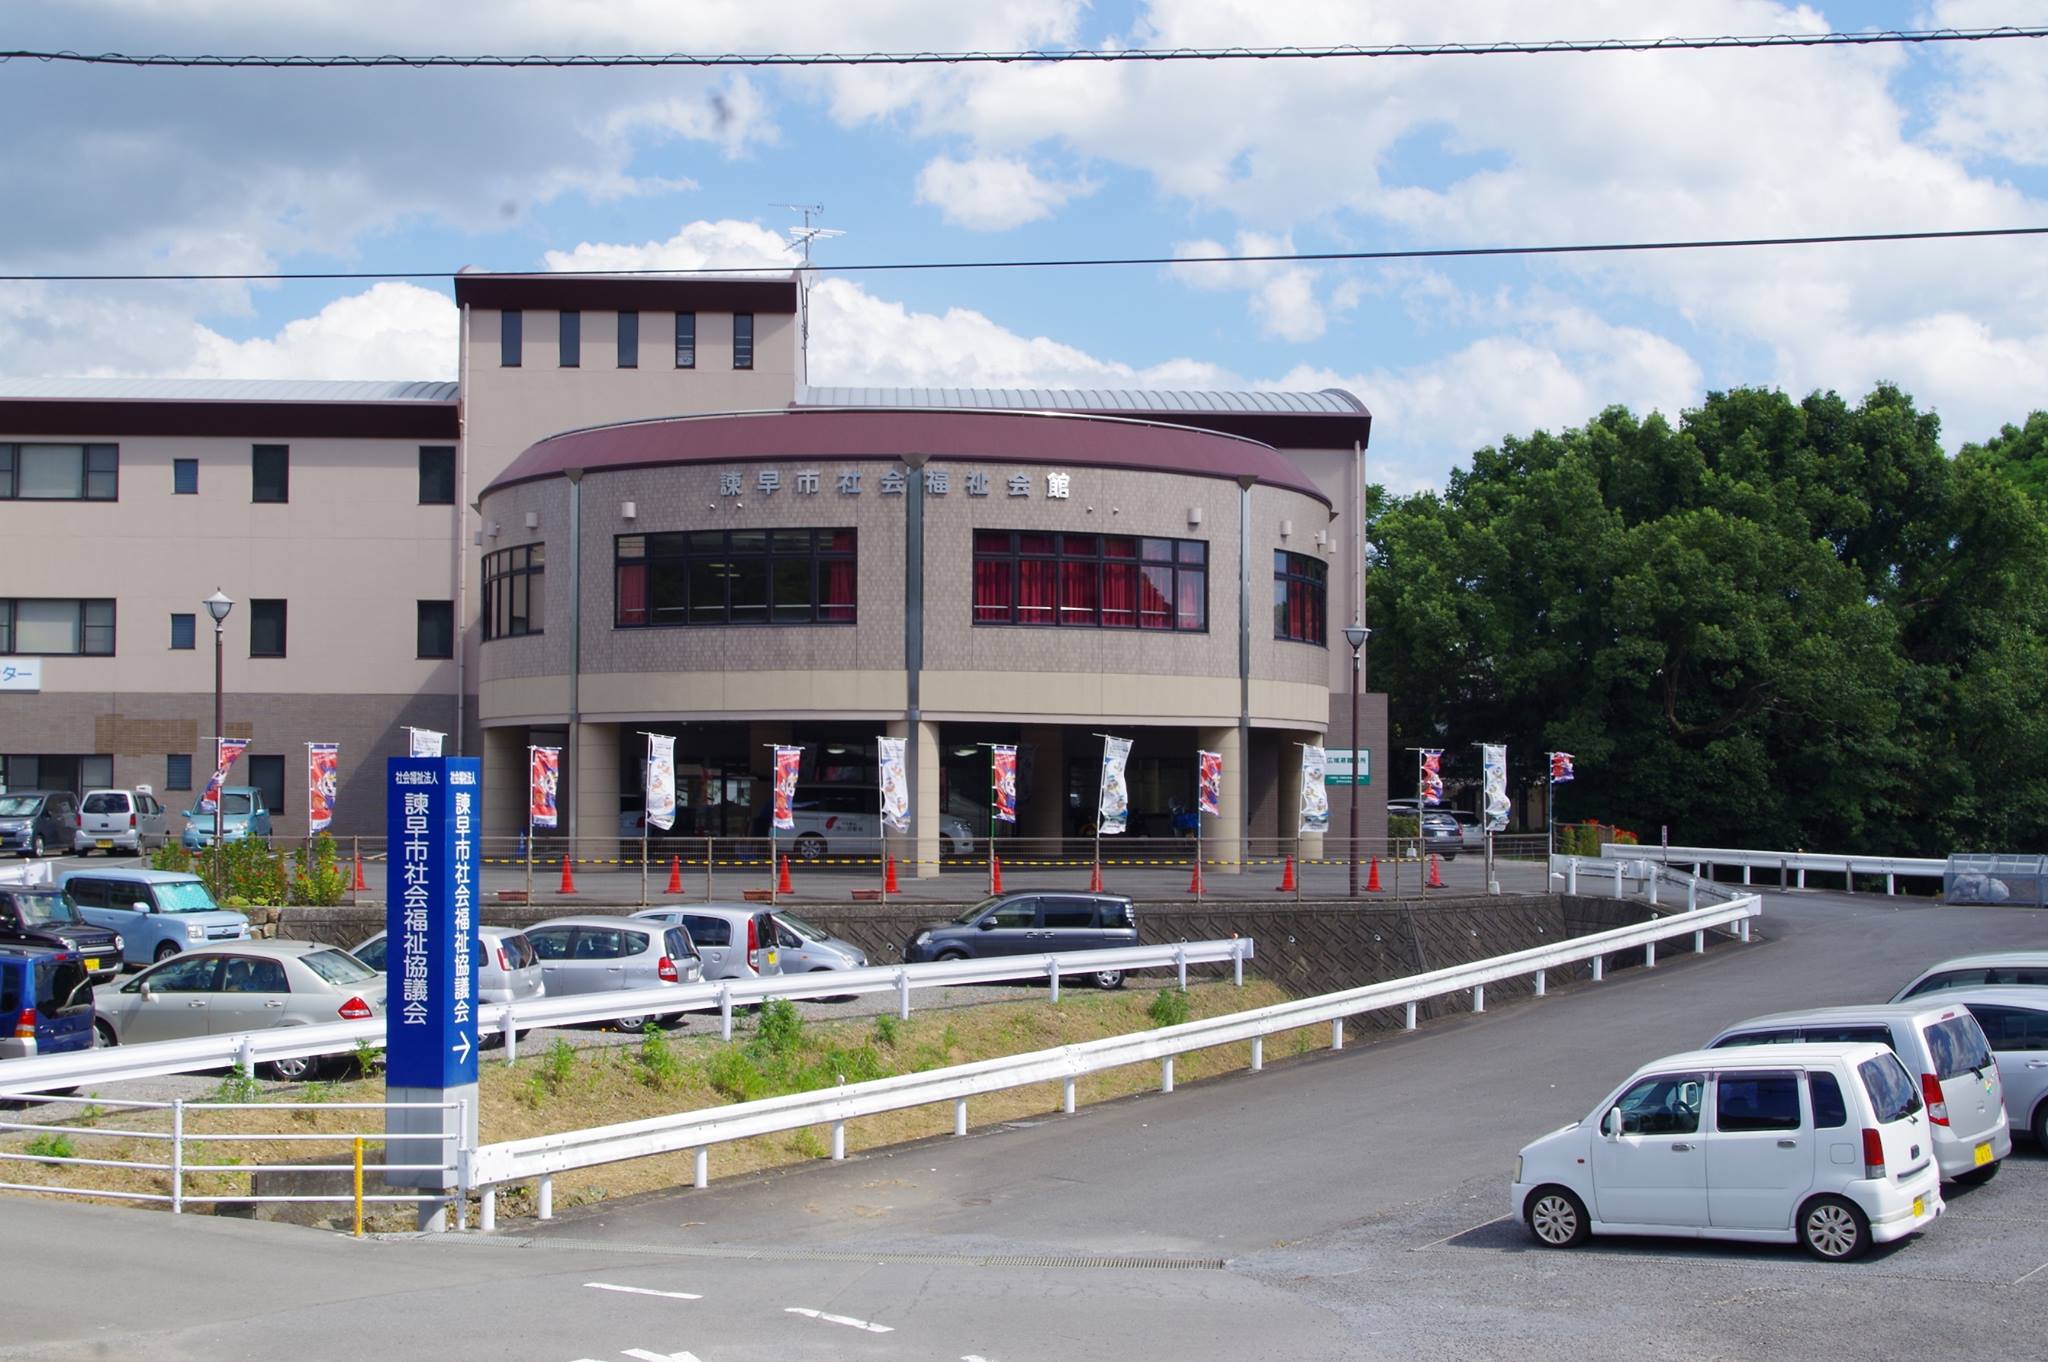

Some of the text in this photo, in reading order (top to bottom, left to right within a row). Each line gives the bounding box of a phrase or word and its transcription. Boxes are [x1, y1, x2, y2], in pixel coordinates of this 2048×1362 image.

[720, 469, 1070, 498] 諫早市社会福祉会館
[395, 771, 439, 785] 社会福祉法人
[403, 792, 429, 1025] 諫早市社会福祉協議会
[454, 792, 471, 1024] 諫早市社会福祉協議会
